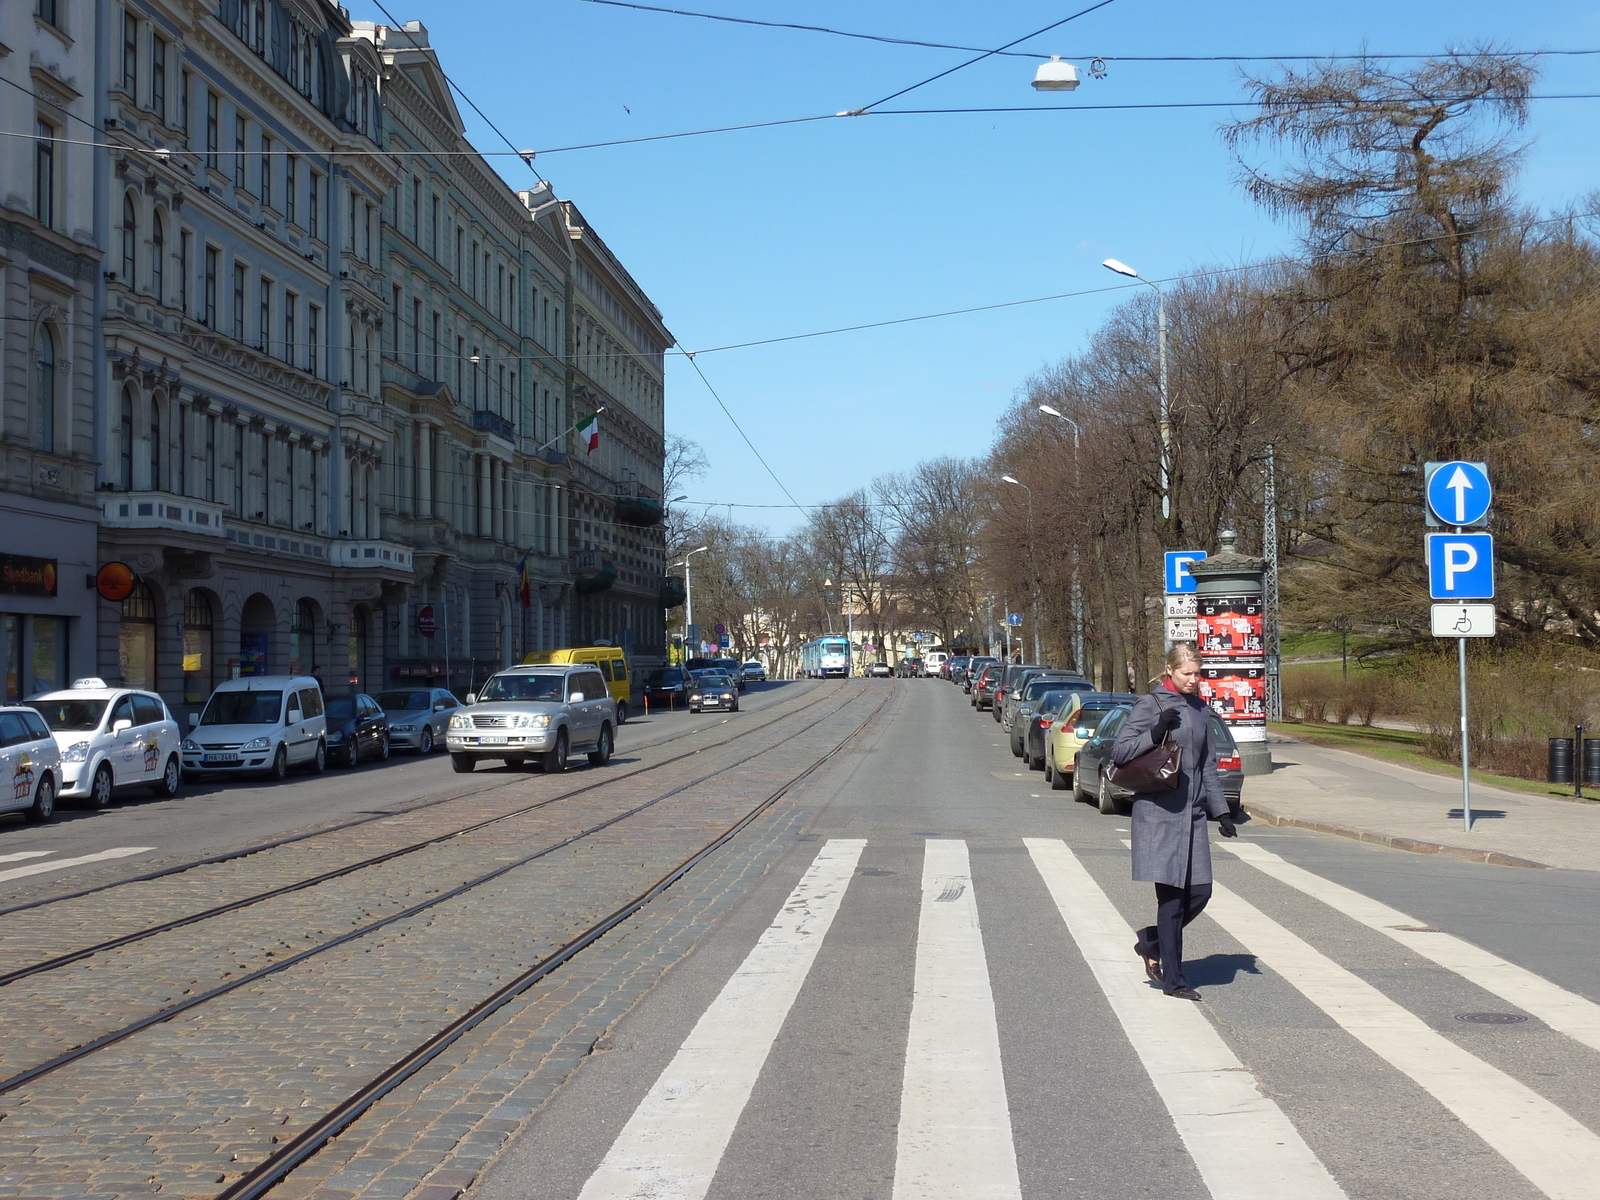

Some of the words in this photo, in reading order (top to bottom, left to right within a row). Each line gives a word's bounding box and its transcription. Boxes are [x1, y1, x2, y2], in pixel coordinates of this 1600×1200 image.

[3, 565, 44, 584] Swedbank
[1175, 557, 1196, 588] P
[1443, 543, 1478, 590] P
